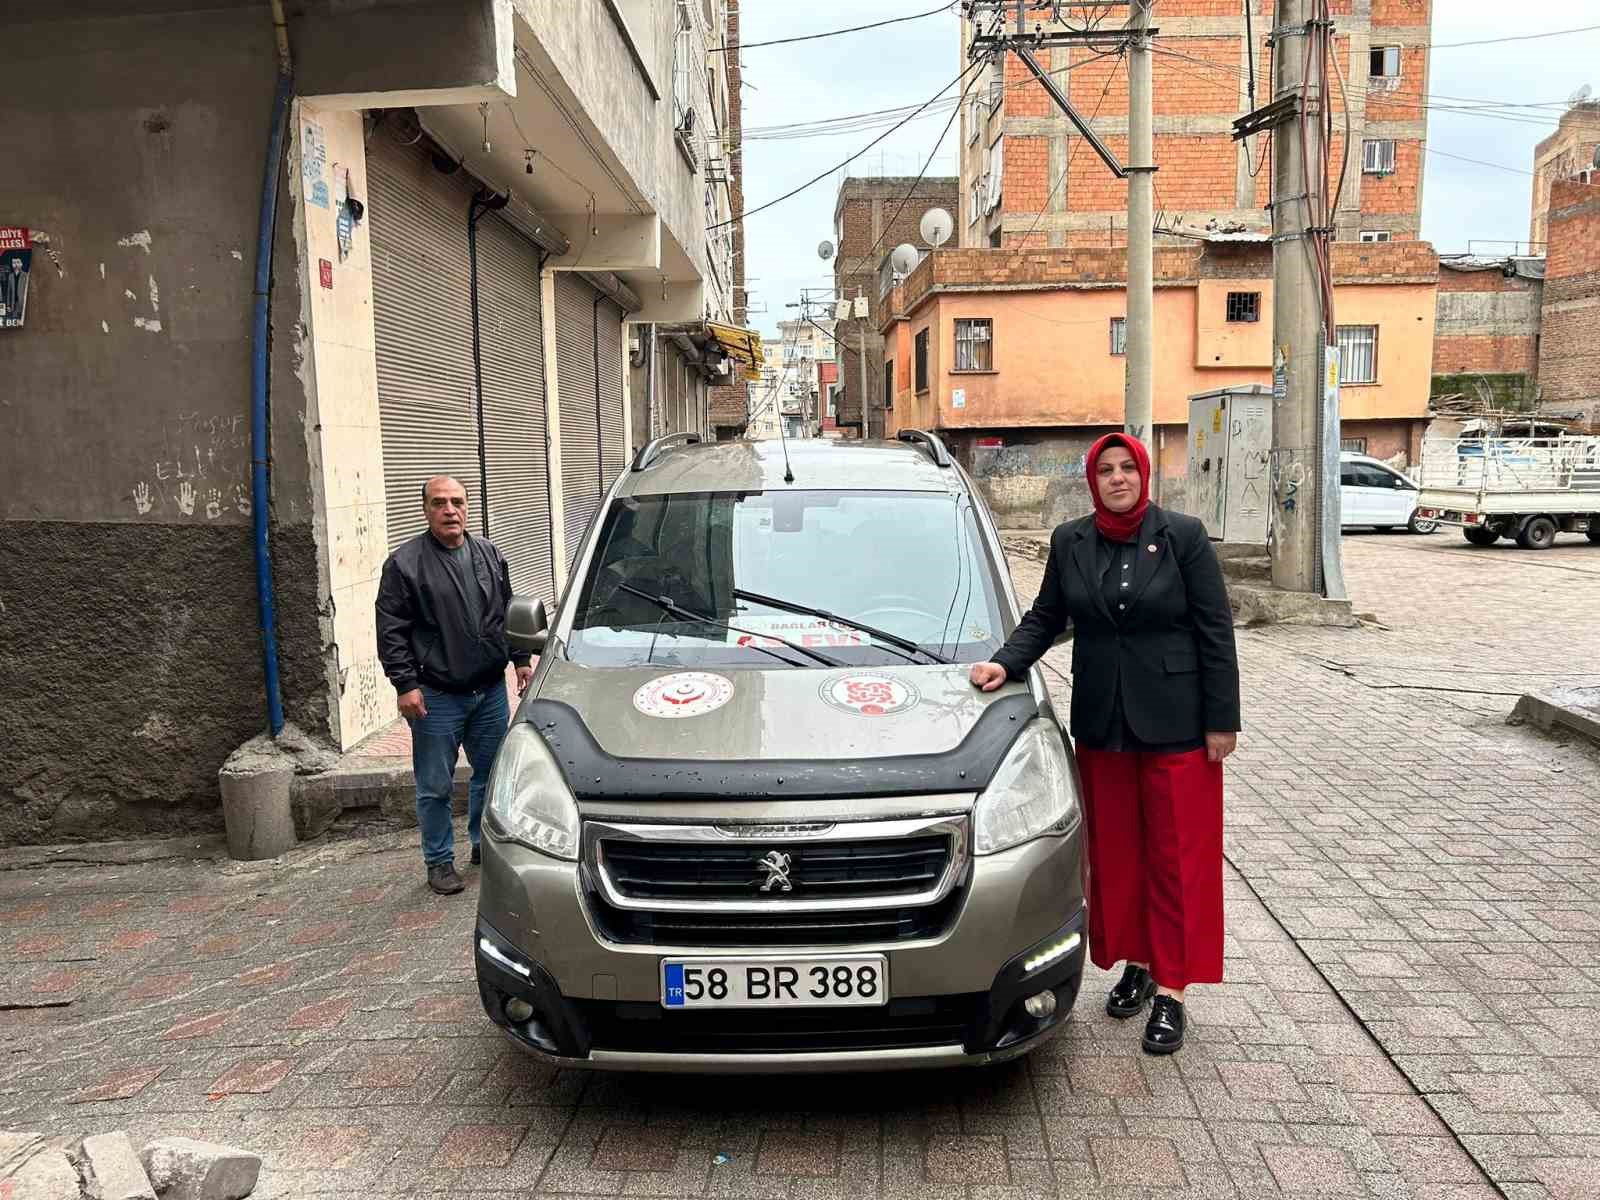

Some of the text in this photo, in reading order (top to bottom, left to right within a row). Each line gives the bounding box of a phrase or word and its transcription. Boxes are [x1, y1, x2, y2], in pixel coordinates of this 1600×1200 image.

[668, 987, 682, 997] TR
[684, 966, 877, 999] 58 BR 388
